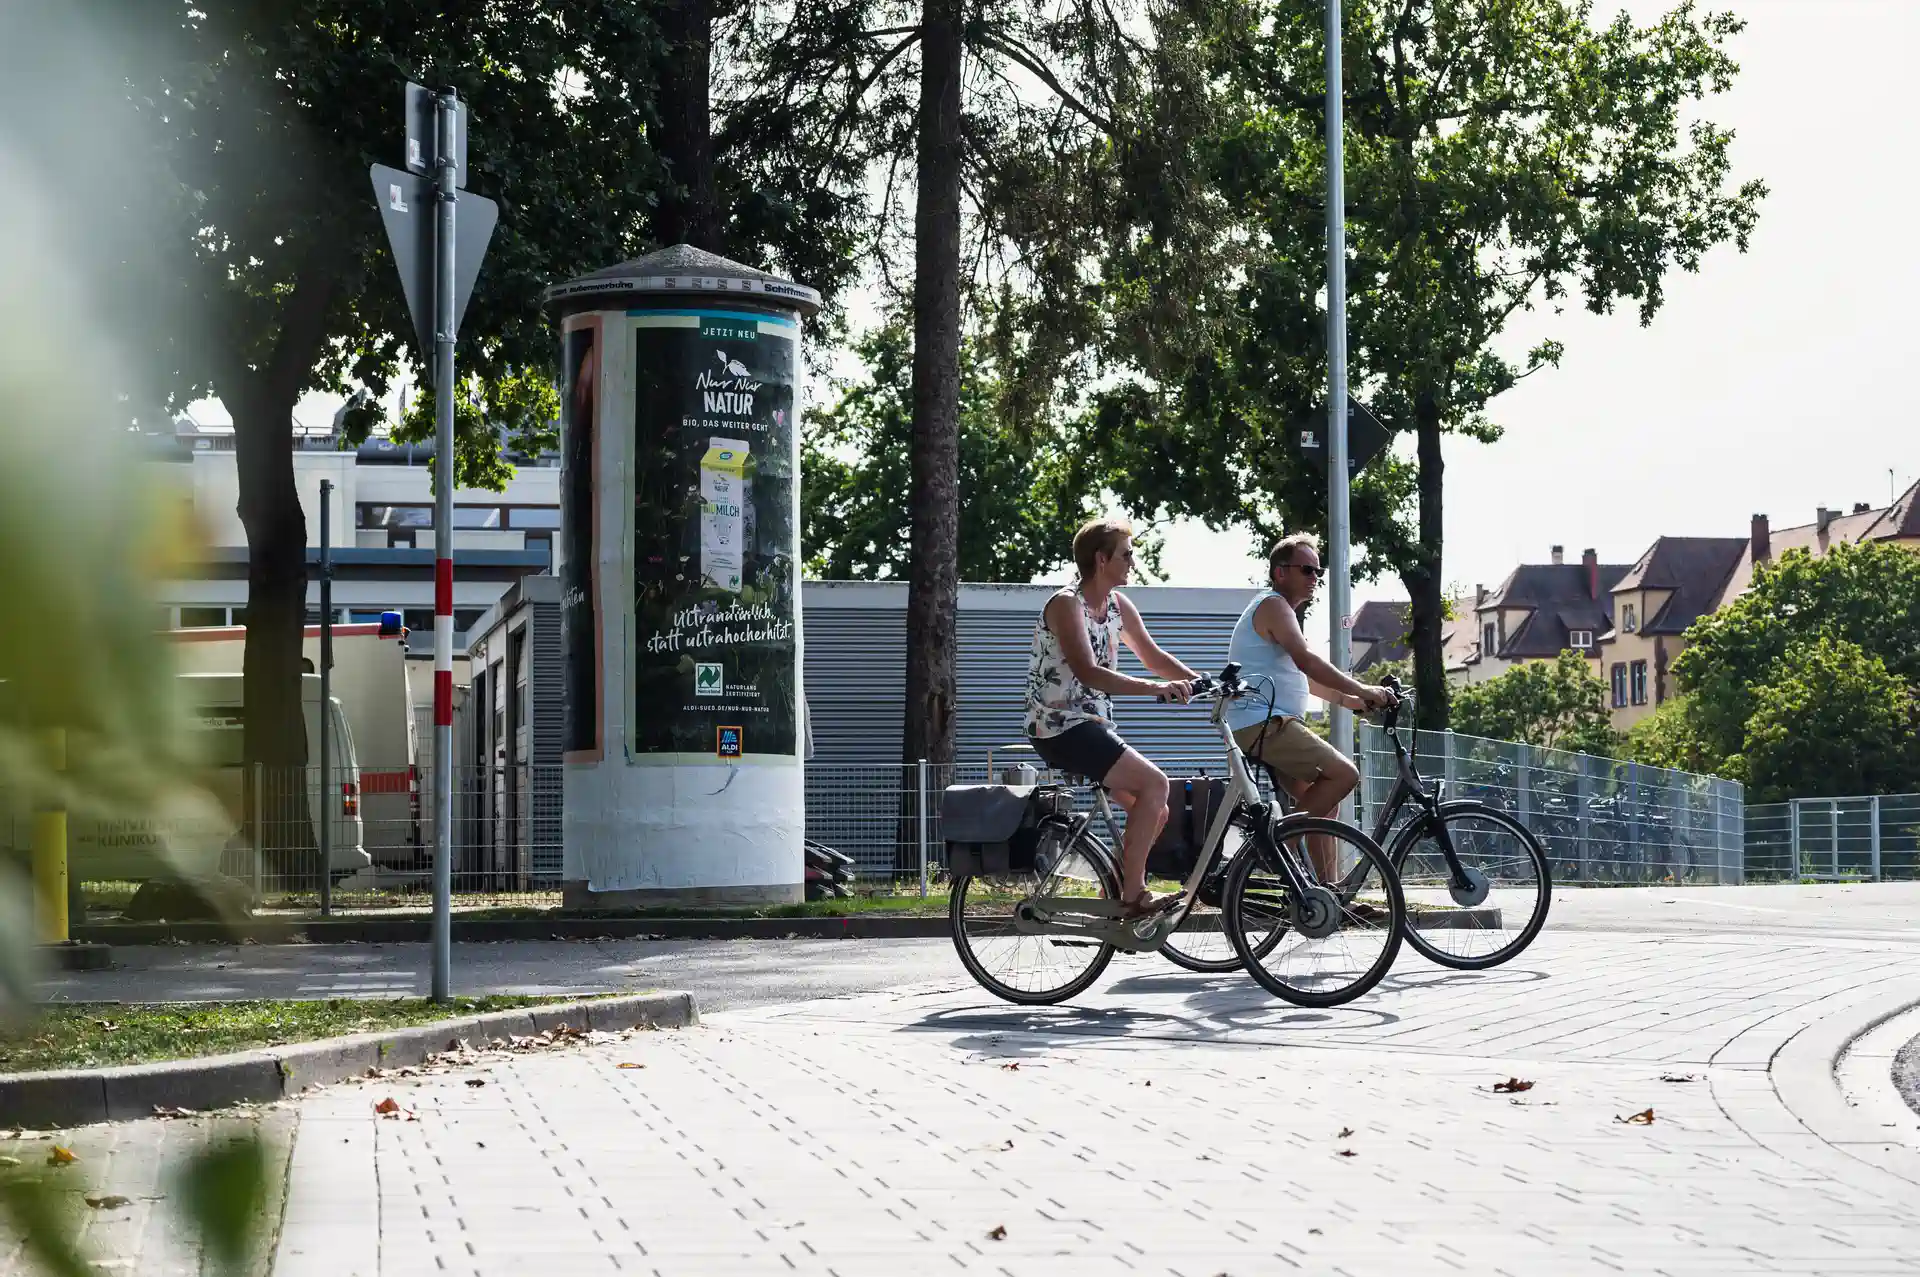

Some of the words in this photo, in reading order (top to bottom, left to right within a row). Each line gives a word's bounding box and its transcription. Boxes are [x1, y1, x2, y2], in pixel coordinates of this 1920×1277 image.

[703, 327, 733, 337] JETZT
[737, 330, 756, 339] NEU
[695, 369, 732, 390] Nur
[734, 377, 762, 392] Nur
[703, 391, 753, 415] NATUR
[682, 419, 700, 428] BIO,
[703, 419, 719, 428] DAS
[721, 421, 750, 430] WEITER
[751, 423, 769, 432] GEHT
[646, 628, 684, 653] statt
[721, 743, 738, 751] ALDI
